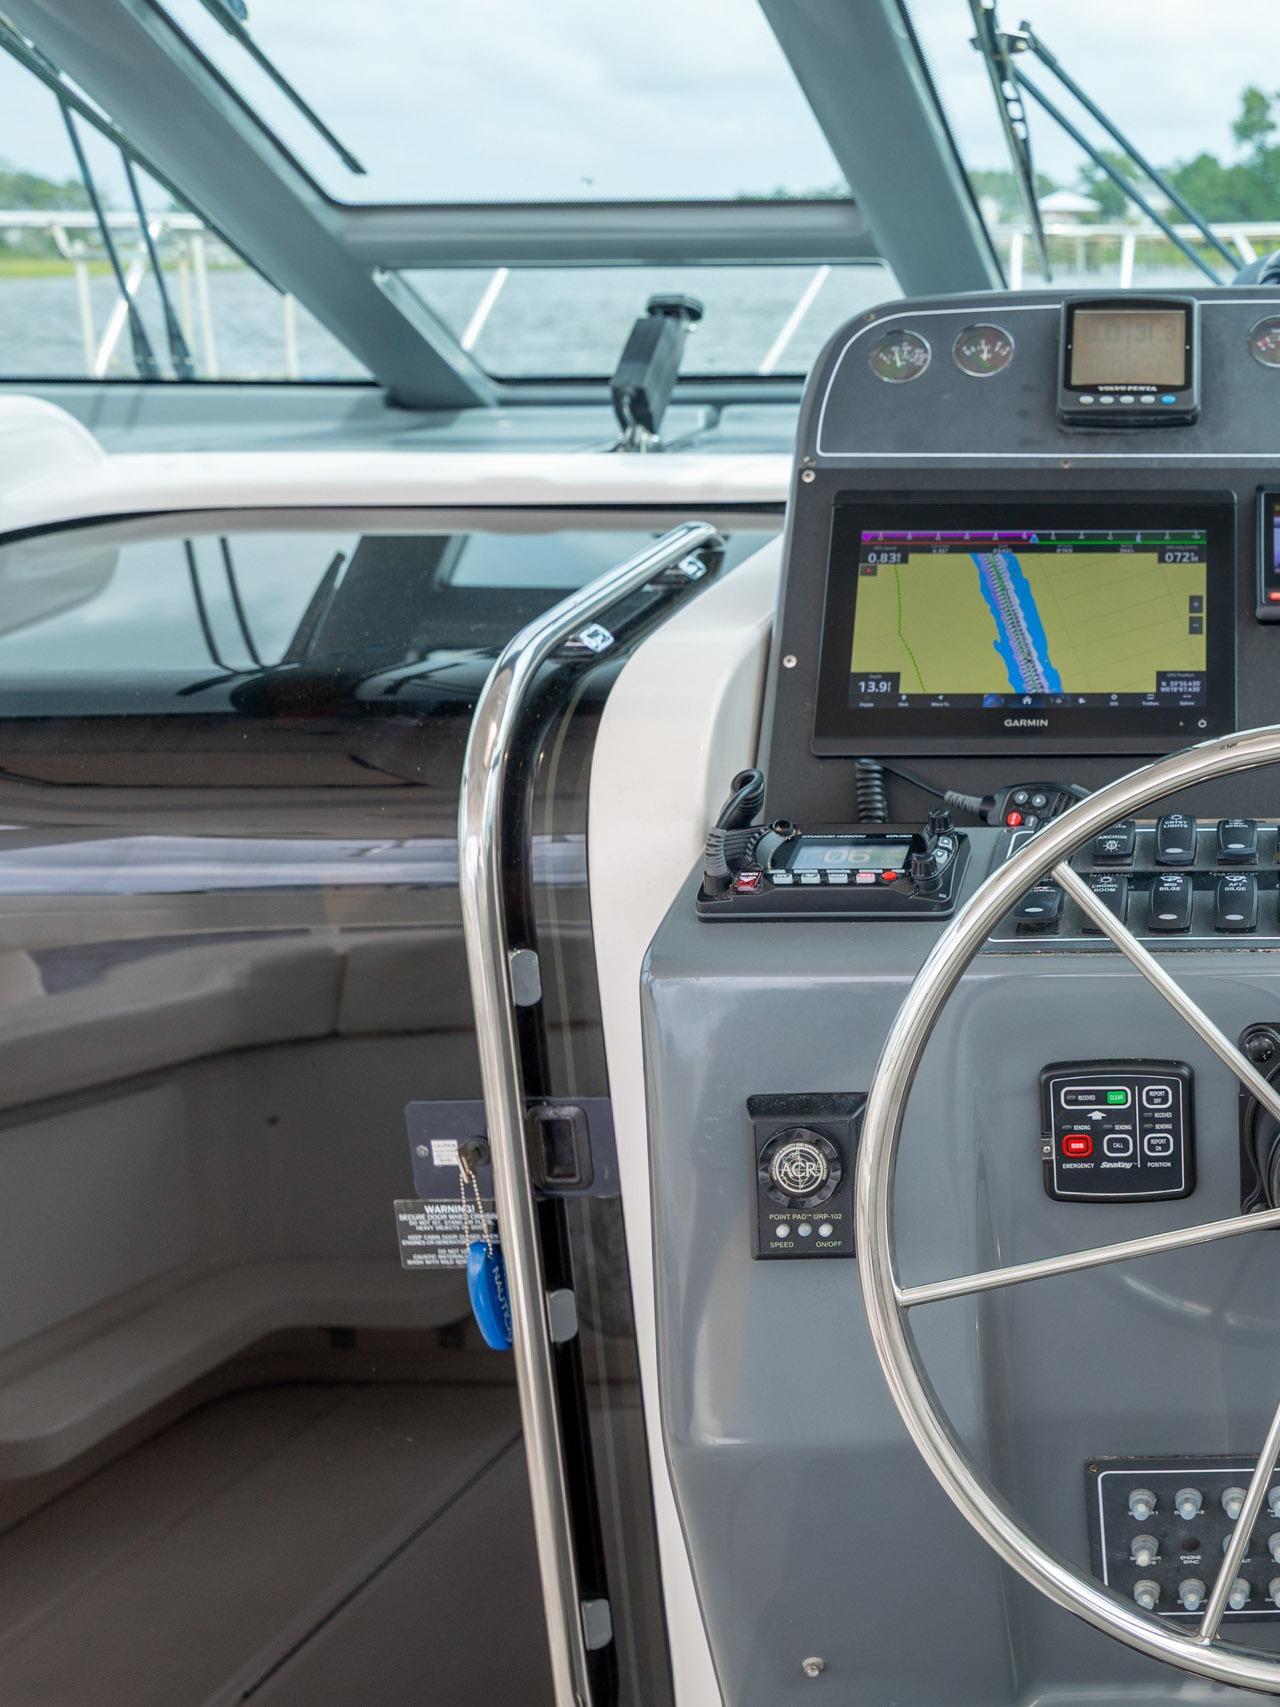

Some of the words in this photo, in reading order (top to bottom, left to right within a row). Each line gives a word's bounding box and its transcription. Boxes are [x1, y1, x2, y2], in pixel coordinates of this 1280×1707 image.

[859, 681, 887, 692] 13.9
[1004, 719, 1048, 727] GARMIN
[823, 849, 871, 864] 06
[424, 1204, 475, 1214] WARNING!
[816, 1240, 843, 1248] ON/OFF
